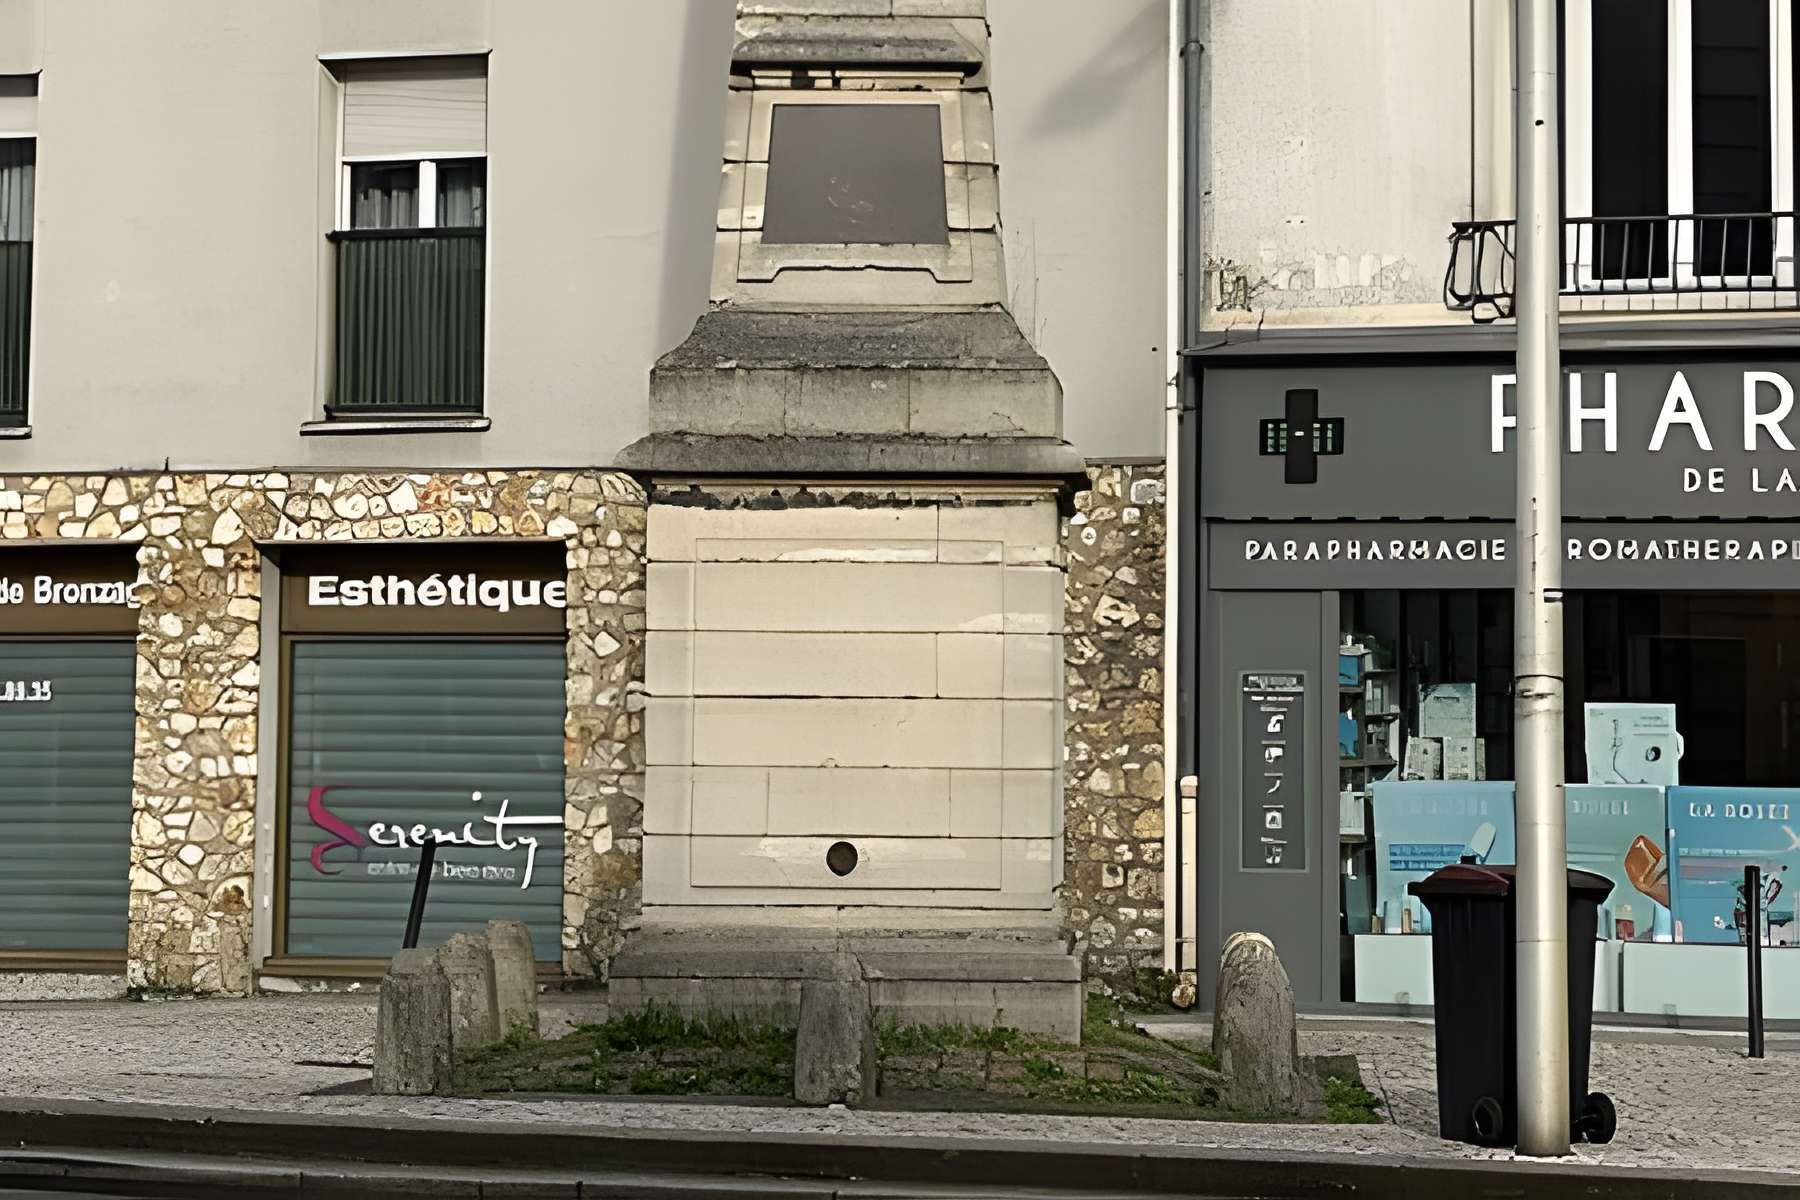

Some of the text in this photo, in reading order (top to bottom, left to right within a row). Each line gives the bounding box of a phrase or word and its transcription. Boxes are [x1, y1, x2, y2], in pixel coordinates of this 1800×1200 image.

[1683, 467, 1797, 493] DE LA
[308, 573, 567, 612] Esthétique
